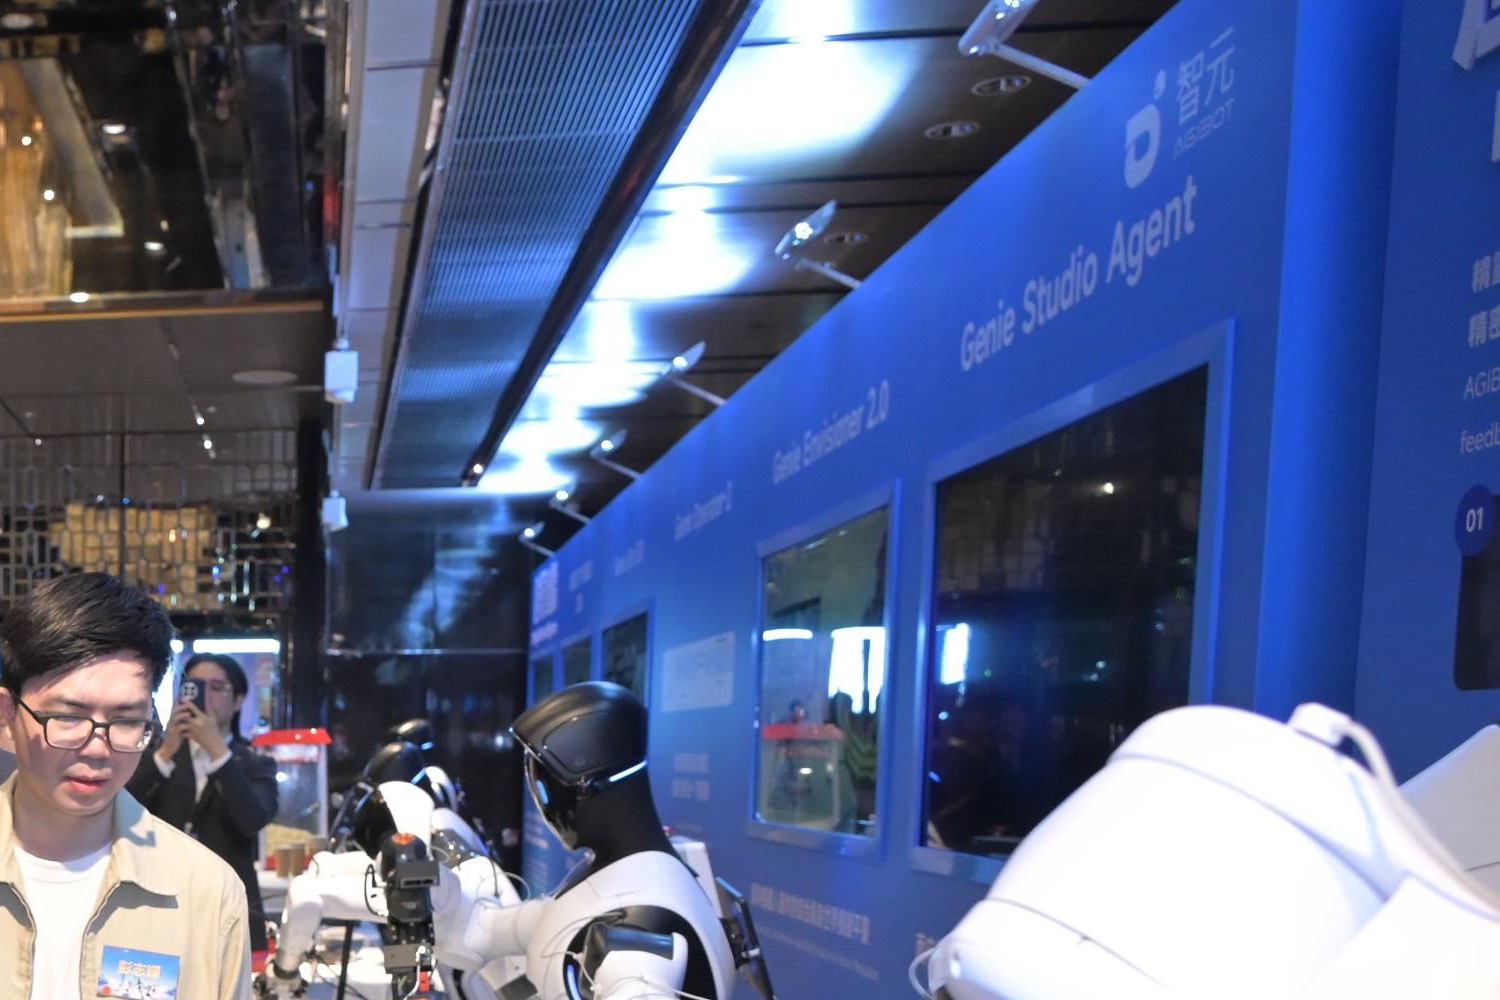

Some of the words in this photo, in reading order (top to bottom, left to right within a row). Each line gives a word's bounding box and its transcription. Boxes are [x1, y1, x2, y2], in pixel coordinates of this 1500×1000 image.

[1175, 26, 1236, 127] 智元
[1172, 97, 1236, 160] AGIBOT
[960, 298, 1016, 372] Genie
[1021, 244, 1098, 335] Studio
[1105, 174, 1197, 287] Agent
[866, 379, 890, 430] 2.0
[1465, 506, 1484, 533] 01
